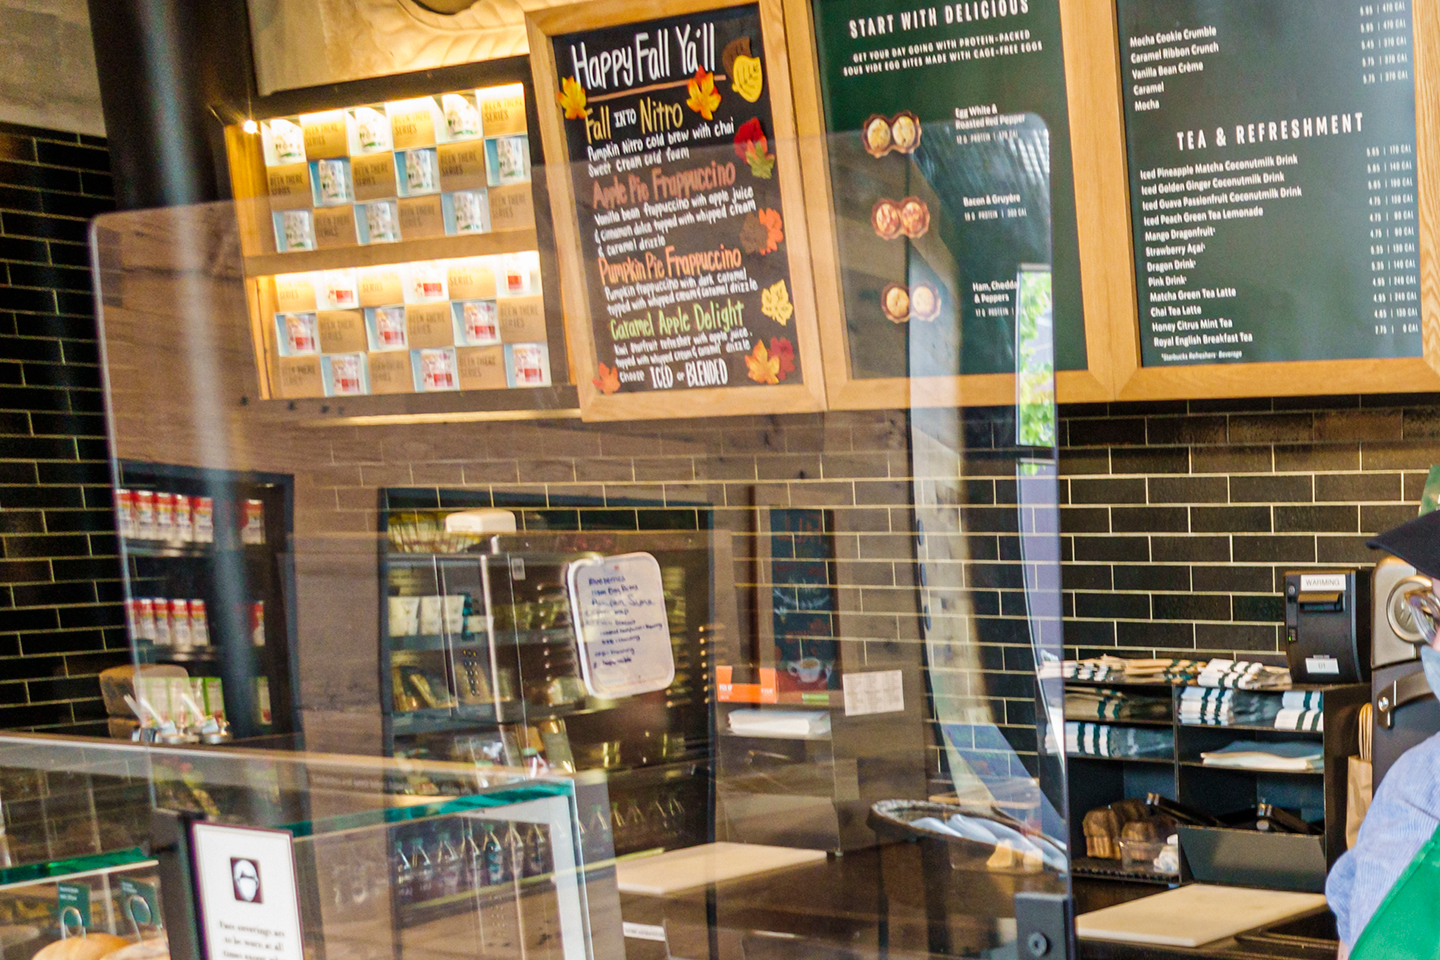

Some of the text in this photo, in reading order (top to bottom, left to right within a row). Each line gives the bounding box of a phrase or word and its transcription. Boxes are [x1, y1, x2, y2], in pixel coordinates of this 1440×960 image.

[849, 0, 1029, 39] START WITH DELICIOUS
[571, 41, 633, 90] Happy
[635, 28, 671, 82] Fall
[585, 96, 683, 144] Fall INTO Nitro
[1177, 112, 1363, 151] TEA & REFRESHMENT
[628, 172, 650, 205] Pie
[651, 160, 736, 202] Frappuccino
[1140, 154, 1298, 182] Iced Pineapple Matcha Coconutmilk Drink
[598, 244, 742, 286] Pumpkin Pie Frappuccino
[610, 311, 655, 341] Caramel
[658, 306, 691, 336] Apple
[693, 298, 745, 332] Delight
[649, 365, 673, 389] ICED
[685, 358, 728, 388] BLENDED
[1305, 579, 1341, 587] WARMING
